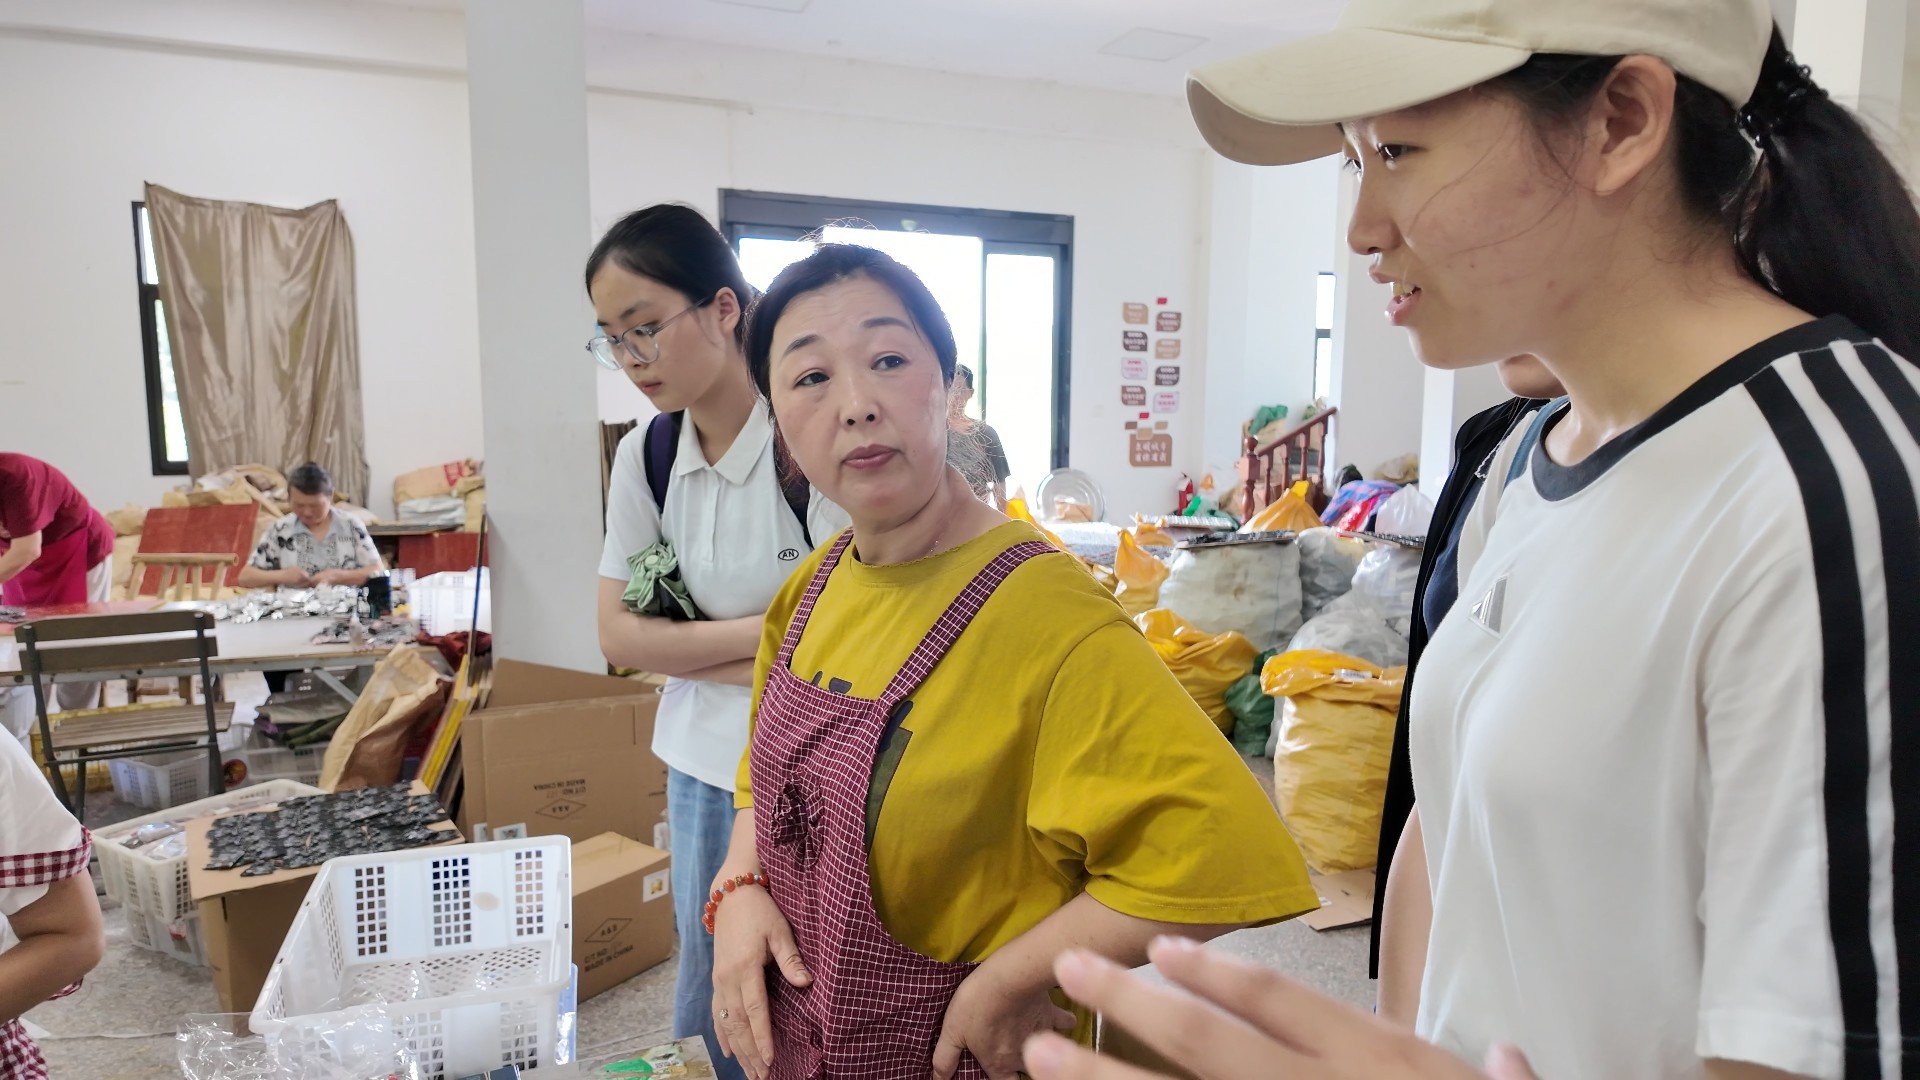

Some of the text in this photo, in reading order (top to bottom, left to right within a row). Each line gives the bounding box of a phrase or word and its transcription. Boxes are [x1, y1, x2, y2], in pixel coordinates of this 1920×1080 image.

[782, 550, 795, 559] AN
[533, 782, 556, 791] CHINA
[566, 779, 586, 788] MADE
[584, 957, 604, 973] MADE
[612, 944, 634, 959] CHINA
